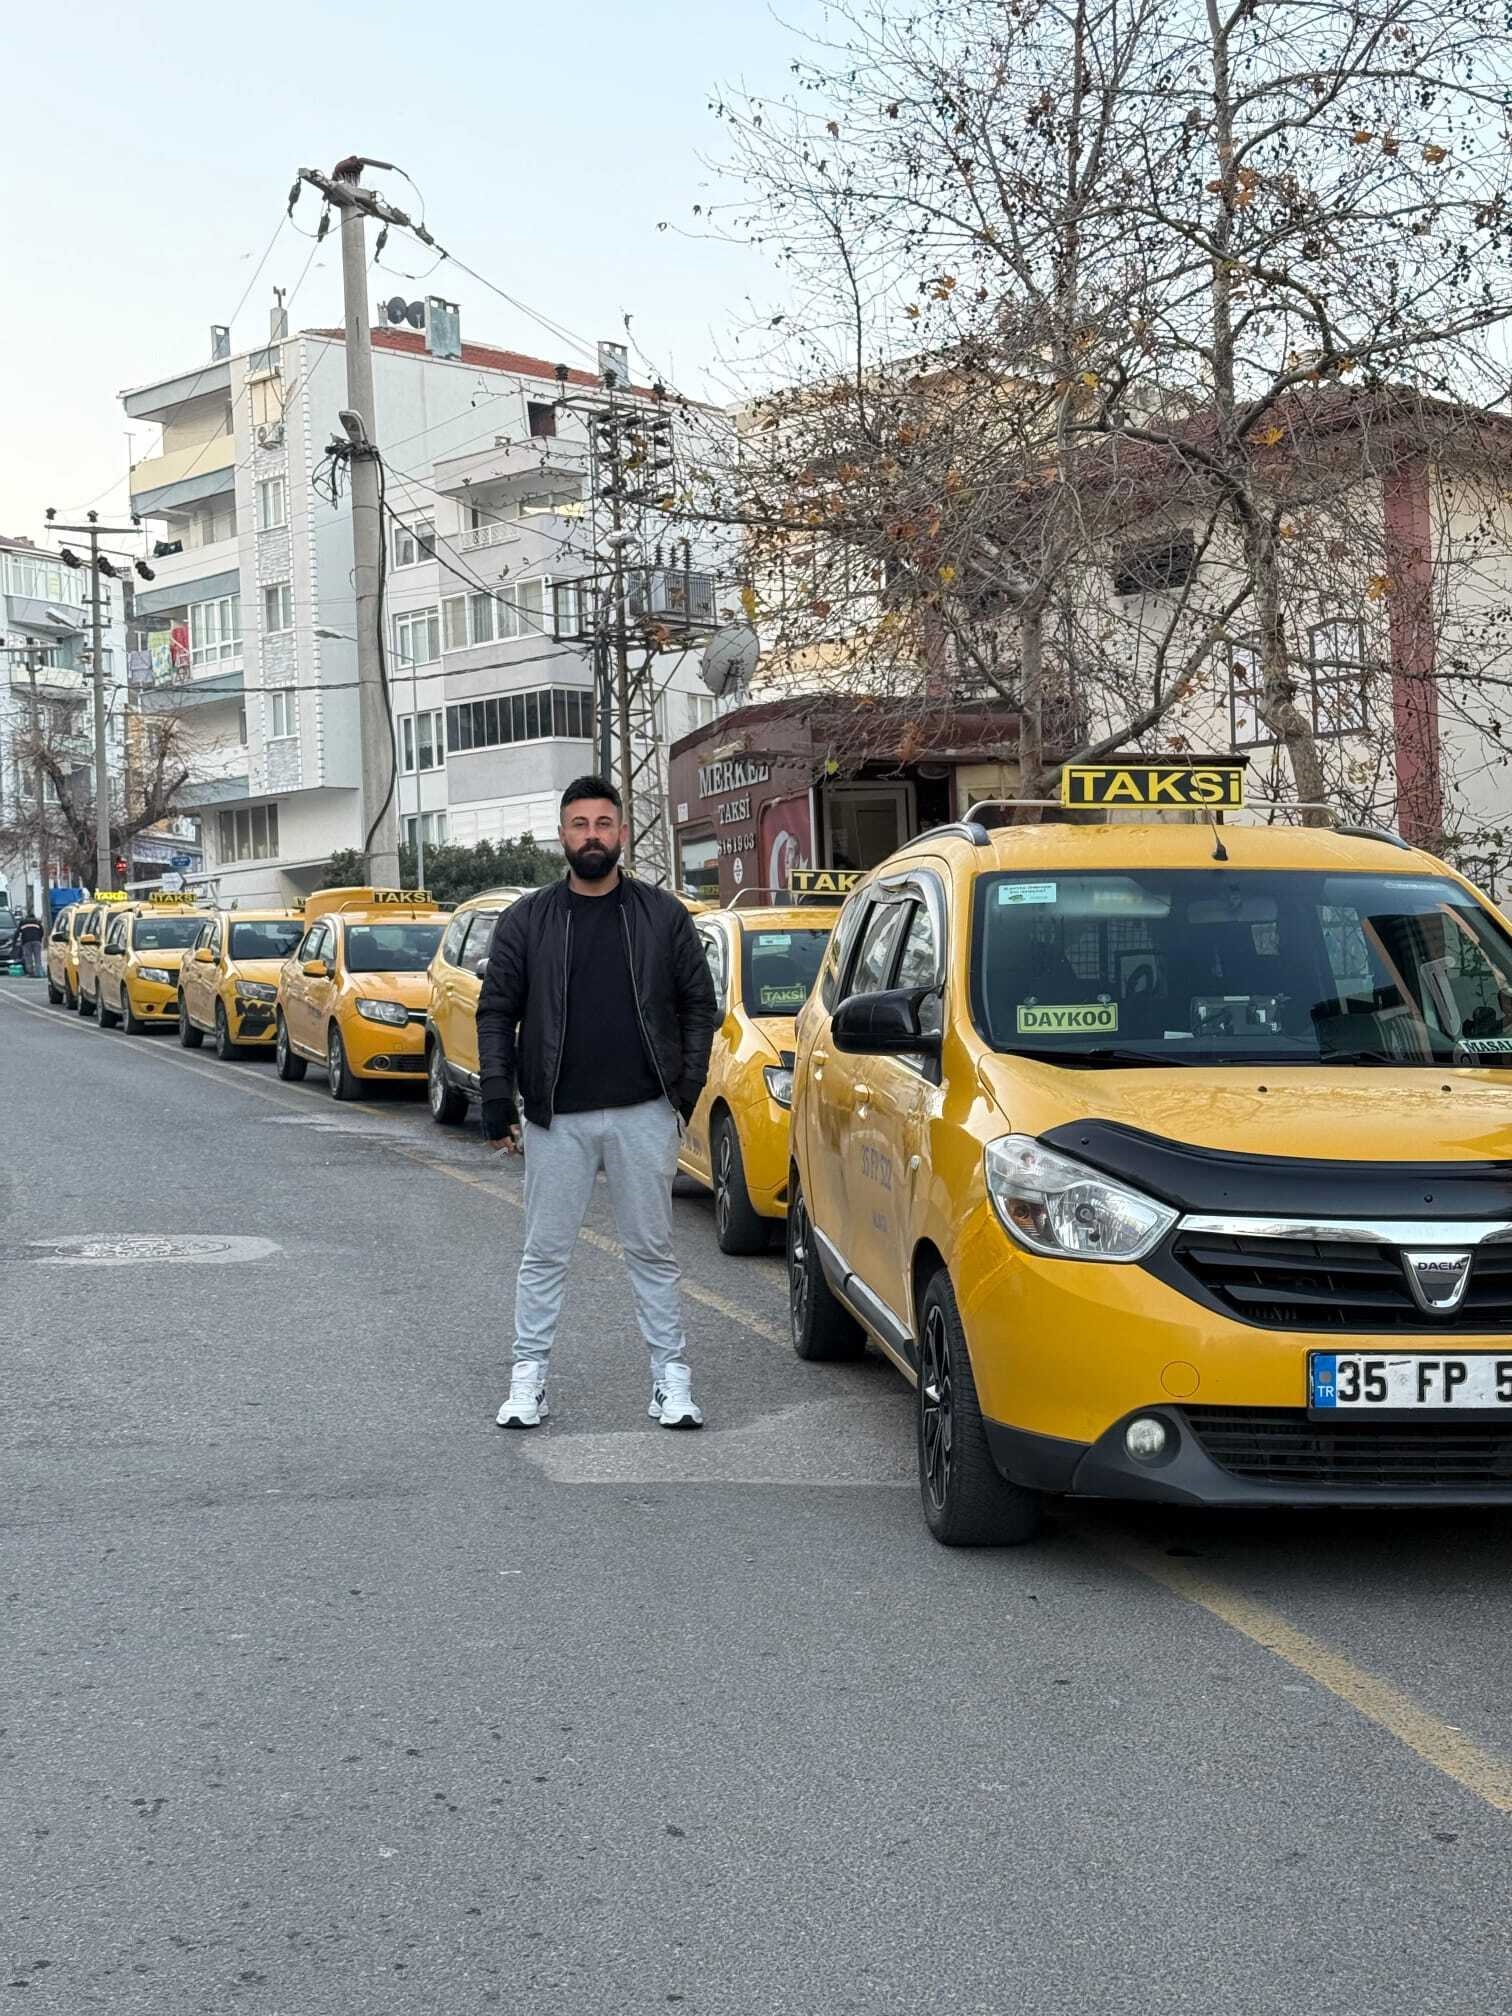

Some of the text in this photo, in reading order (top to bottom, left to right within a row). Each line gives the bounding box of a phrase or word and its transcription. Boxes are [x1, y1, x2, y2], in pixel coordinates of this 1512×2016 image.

[1023, 1010, 1112, 1027] DAYKOO
[1418, 1261, 1463, 1271] DACIA
[1337, 1360, 1388, 1402] 35
[1416, 1361, 1468, 1403] FP
[1317, 1385, 1335, 1398] TR
